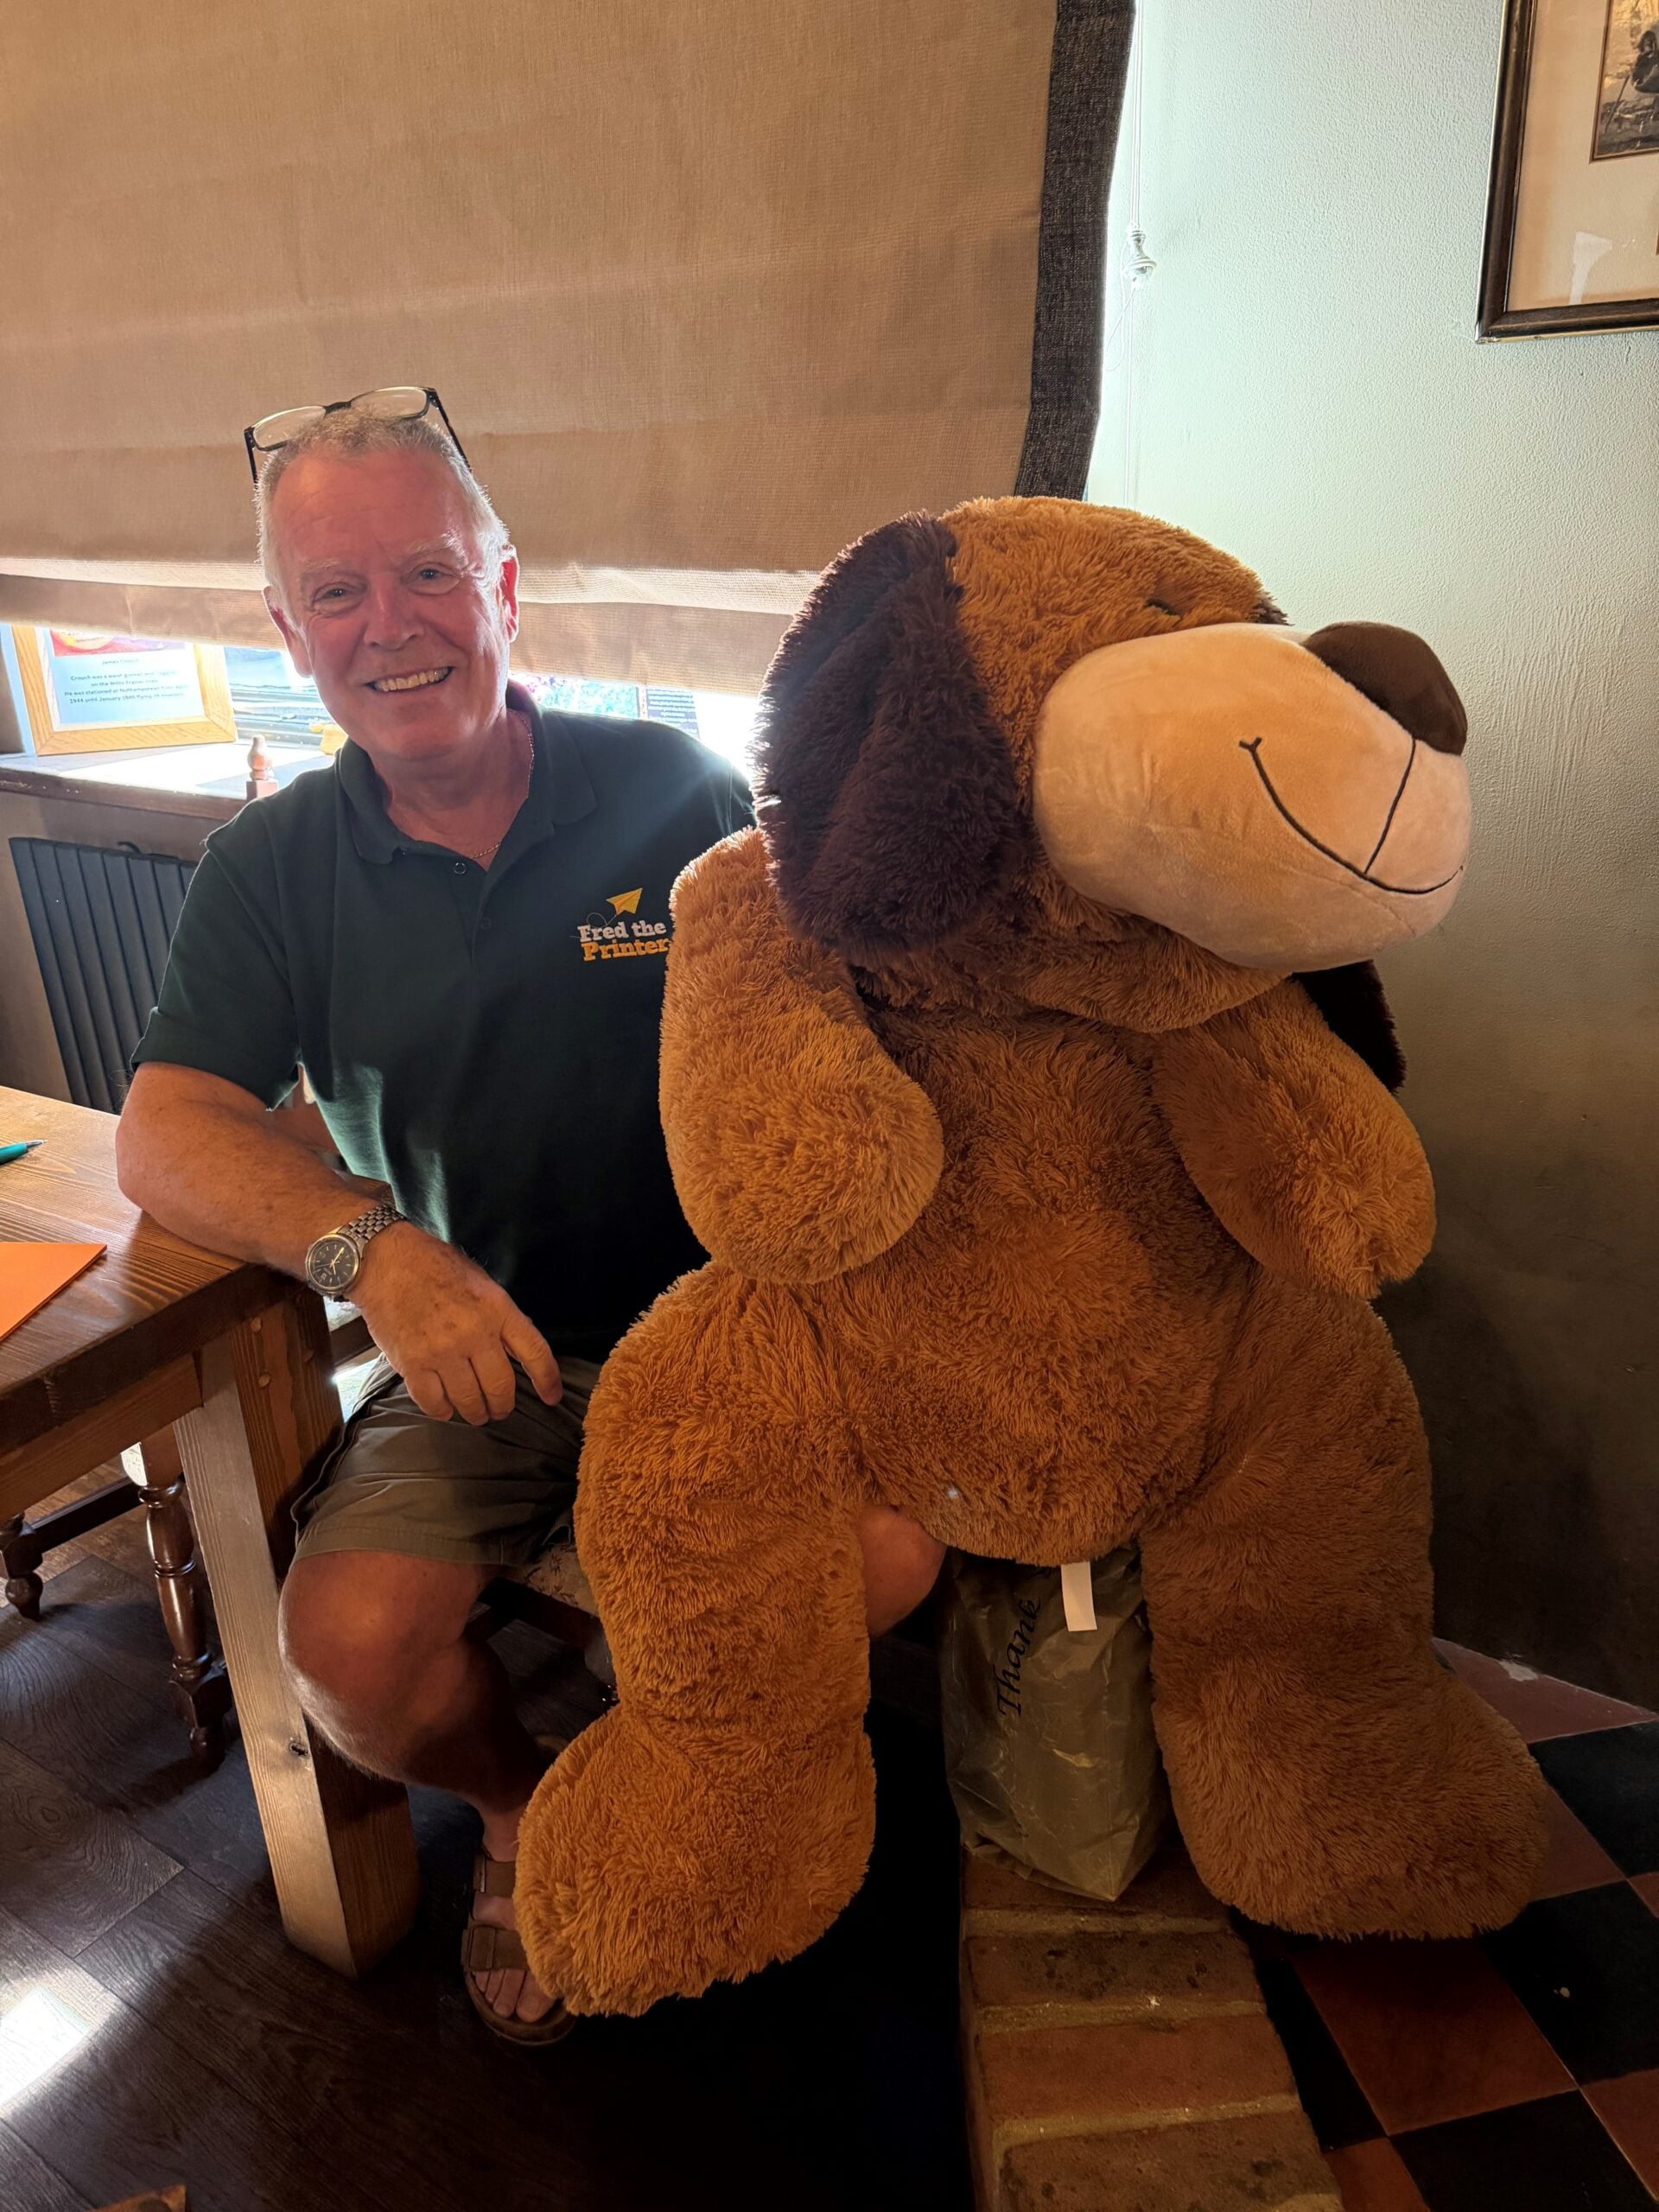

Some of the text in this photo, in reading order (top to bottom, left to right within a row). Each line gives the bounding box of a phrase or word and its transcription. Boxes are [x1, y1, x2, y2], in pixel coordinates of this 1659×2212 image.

[577, 919, 667, 943] Fred the
[993, 1596, 1041, 1716] Thank
